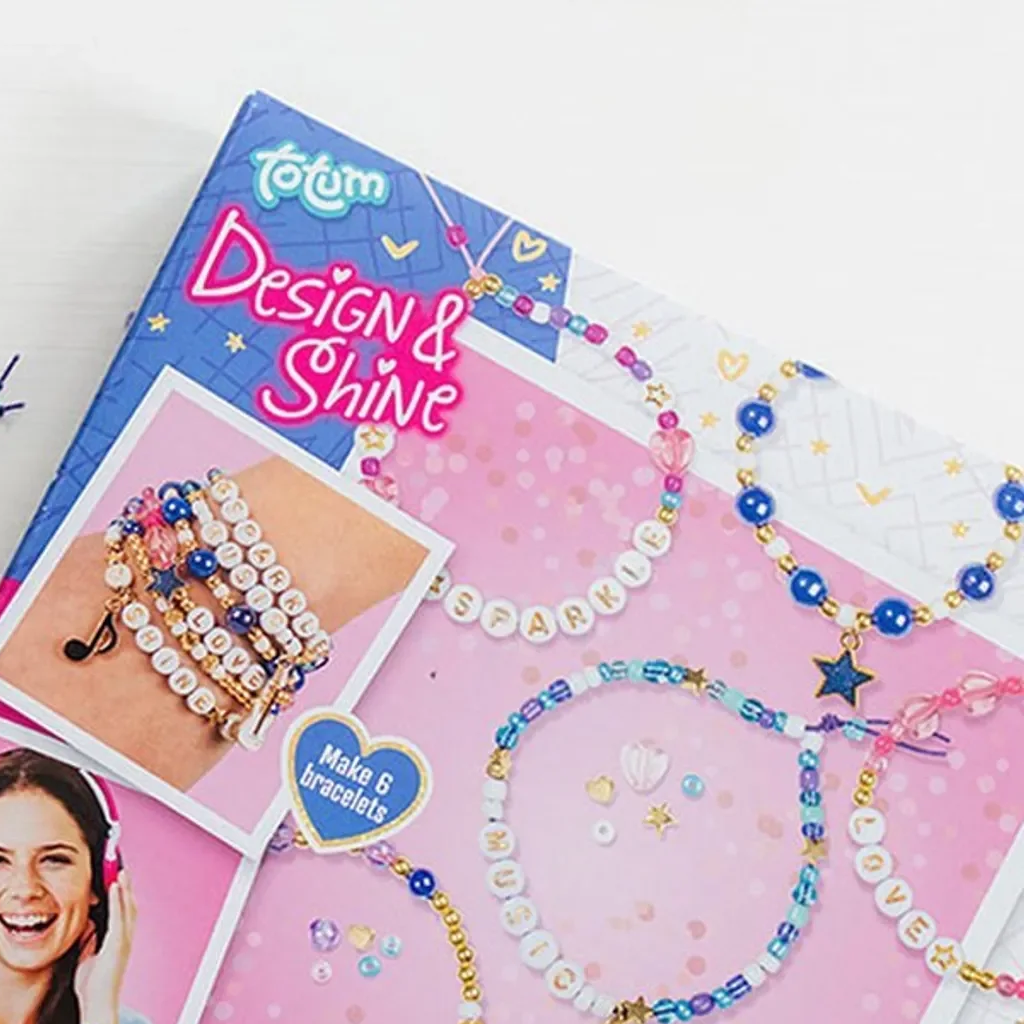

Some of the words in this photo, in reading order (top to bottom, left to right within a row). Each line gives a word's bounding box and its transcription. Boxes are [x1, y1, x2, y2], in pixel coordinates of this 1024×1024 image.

[411, 292, 465, 373] &
[190, 610, 266, 686] LOVE
[298, 761, 389, 825] bracelets
[318, 743, 374, 787] Make
[374, 771, 395, 796] 6
[482, 828, 578, 992] MUSIC
[852, 815, 931, 946] LOVE
